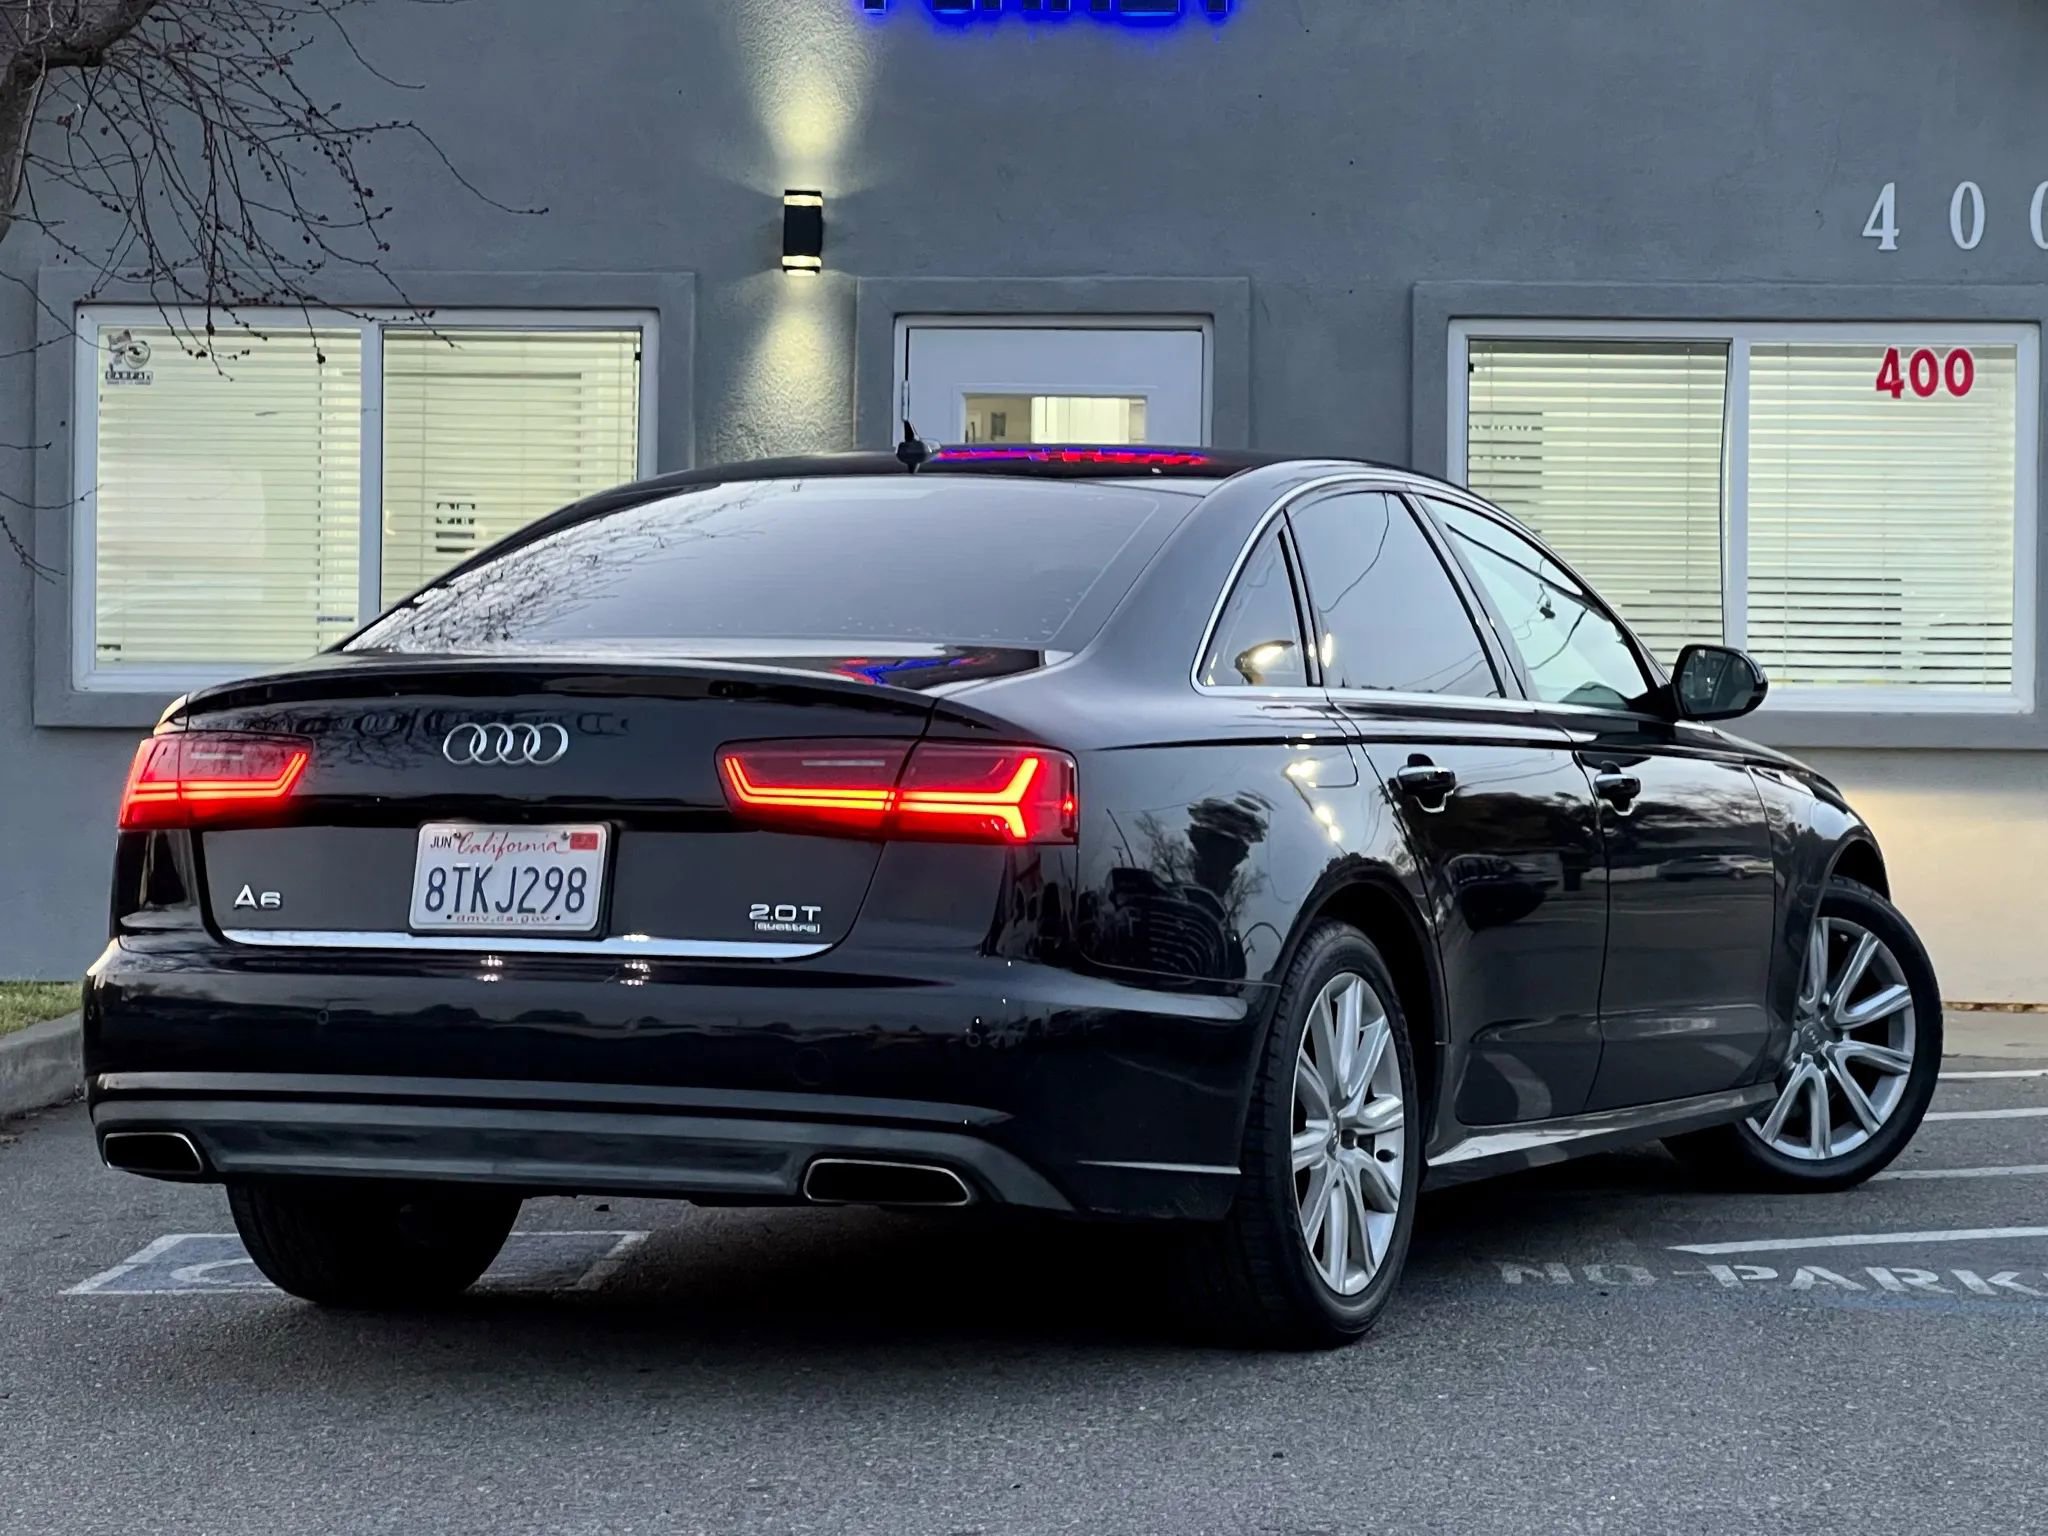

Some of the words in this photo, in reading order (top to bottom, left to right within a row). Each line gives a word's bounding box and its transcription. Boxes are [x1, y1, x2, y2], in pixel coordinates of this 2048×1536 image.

[1876, 347, 1974, 399] 400
[430, 836, 452, 849] JUN
[457, 832, 570, 861] California
[232, 884, 281, 909] A6
[425, 866, 588, 914] 8TKJ298
[749, 903, 822, 921] 2.0T
[1706, 1264, 2048, 1297] PARK
